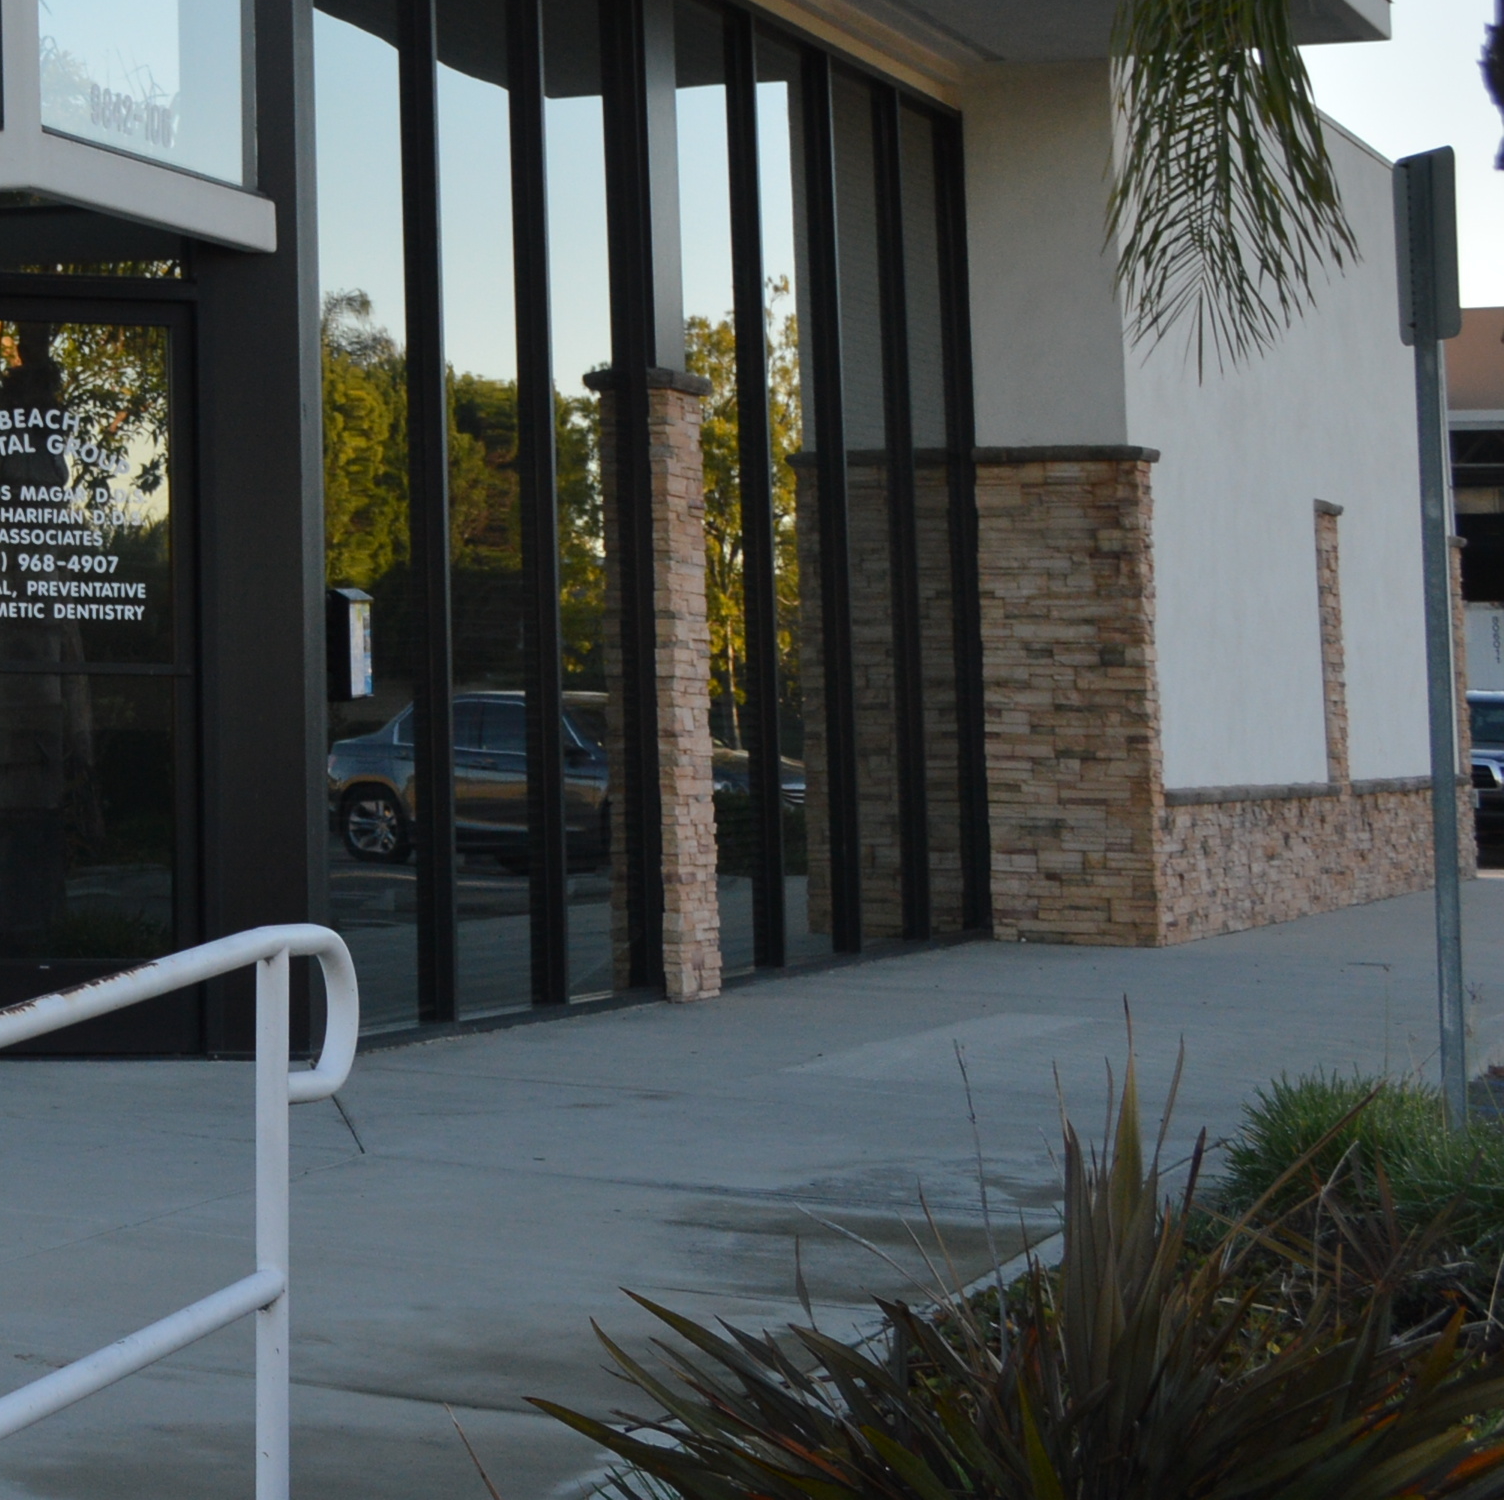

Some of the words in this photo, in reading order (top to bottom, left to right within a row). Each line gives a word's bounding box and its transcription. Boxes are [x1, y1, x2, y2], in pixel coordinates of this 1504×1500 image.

[46, 435, 131, 476] GROUP
[18, 553, 120, 574] 968-4907
[26, 580, 147, 599] PREVENTATIVE
[53, 603, 146, 621] DENTISTRY
